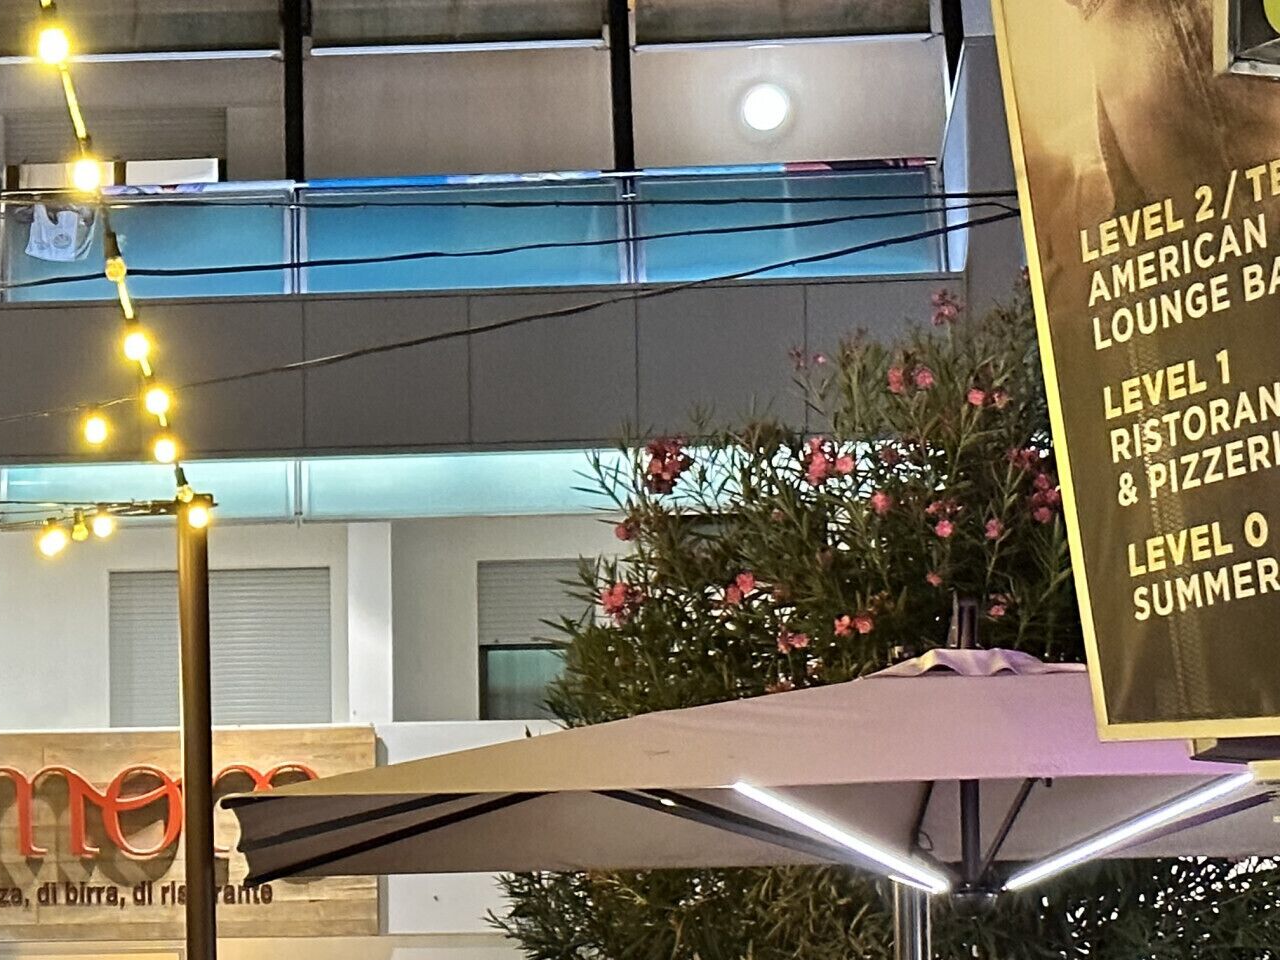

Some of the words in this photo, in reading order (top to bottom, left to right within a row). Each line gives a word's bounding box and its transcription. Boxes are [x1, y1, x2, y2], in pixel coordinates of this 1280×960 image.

[1080, 198, 1184, 263] LEVEL
[1194, 185, 1215, 222] 2
[1088, 213, 1267, 307] AMERICAN
[1093, 274, 1231, 350] LOUNGE
[1103, 359, 1207, 420] LEVEL
[1216, 349, 1230, 384] 1
[1110, 382, 1280, 463] RISTORAN
[1118, 472, 1139, 506] &
[1149, 431, 1280, 499] PIZZERI
[1128, 522, 1233, 577] LEVEL
[1133, 557, 1280, 621] SUMMER
[37, 880, 56, 906] di
[65, 880, 125, 910] birra,
[133, 880, 152, 906] di
[161, 880, 272, 906] risrante
